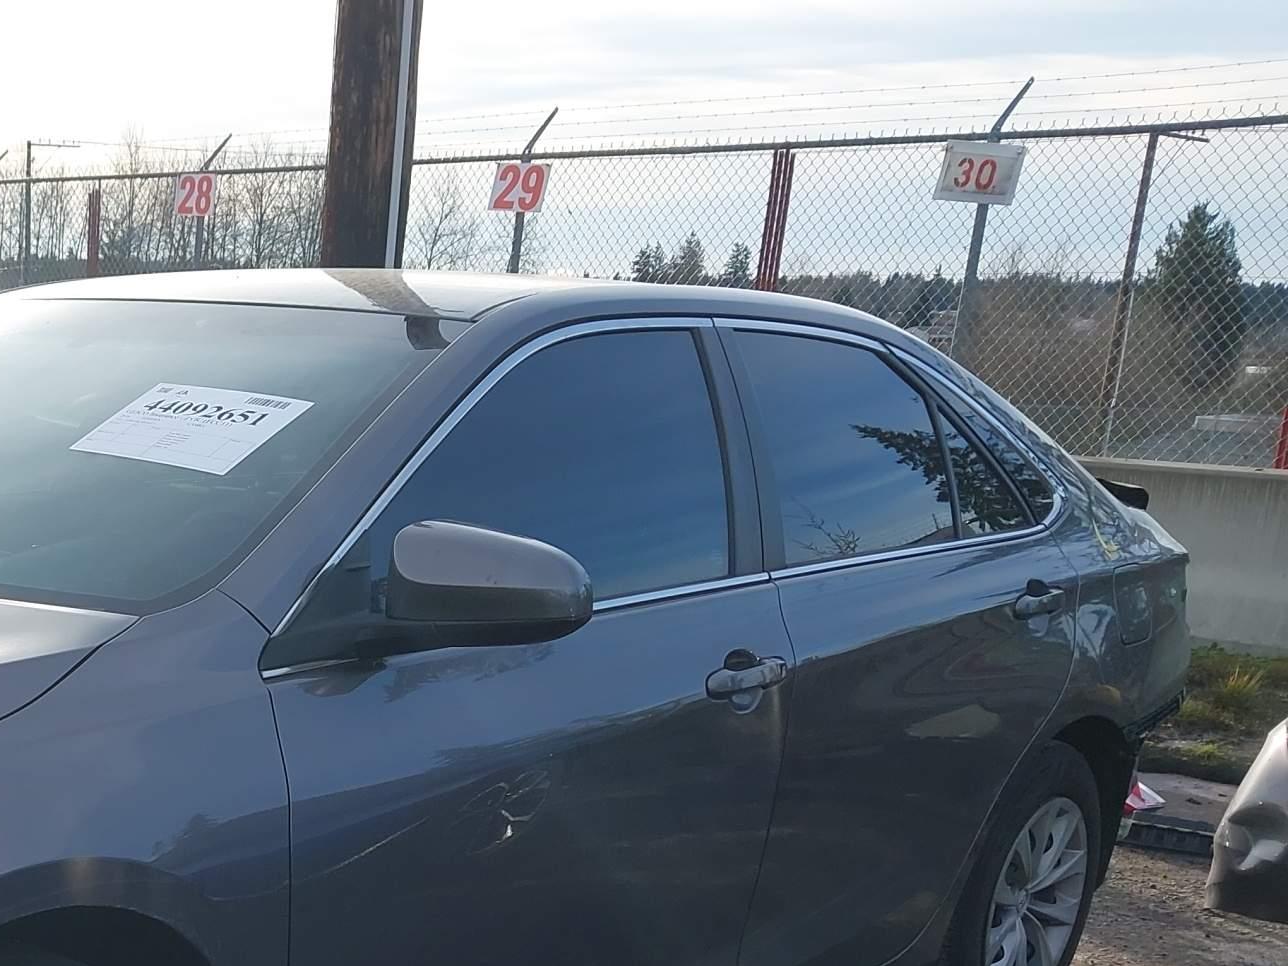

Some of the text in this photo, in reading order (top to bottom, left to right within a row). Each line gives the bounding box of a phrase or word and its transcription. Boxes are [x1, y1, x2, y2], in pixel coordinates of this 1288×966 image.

[493, 165, 545, 211] 29
[953, 157, 997, 190] 30
[178, 176, 213, 215] 28
[143, 398, 270, 427] 44092651
